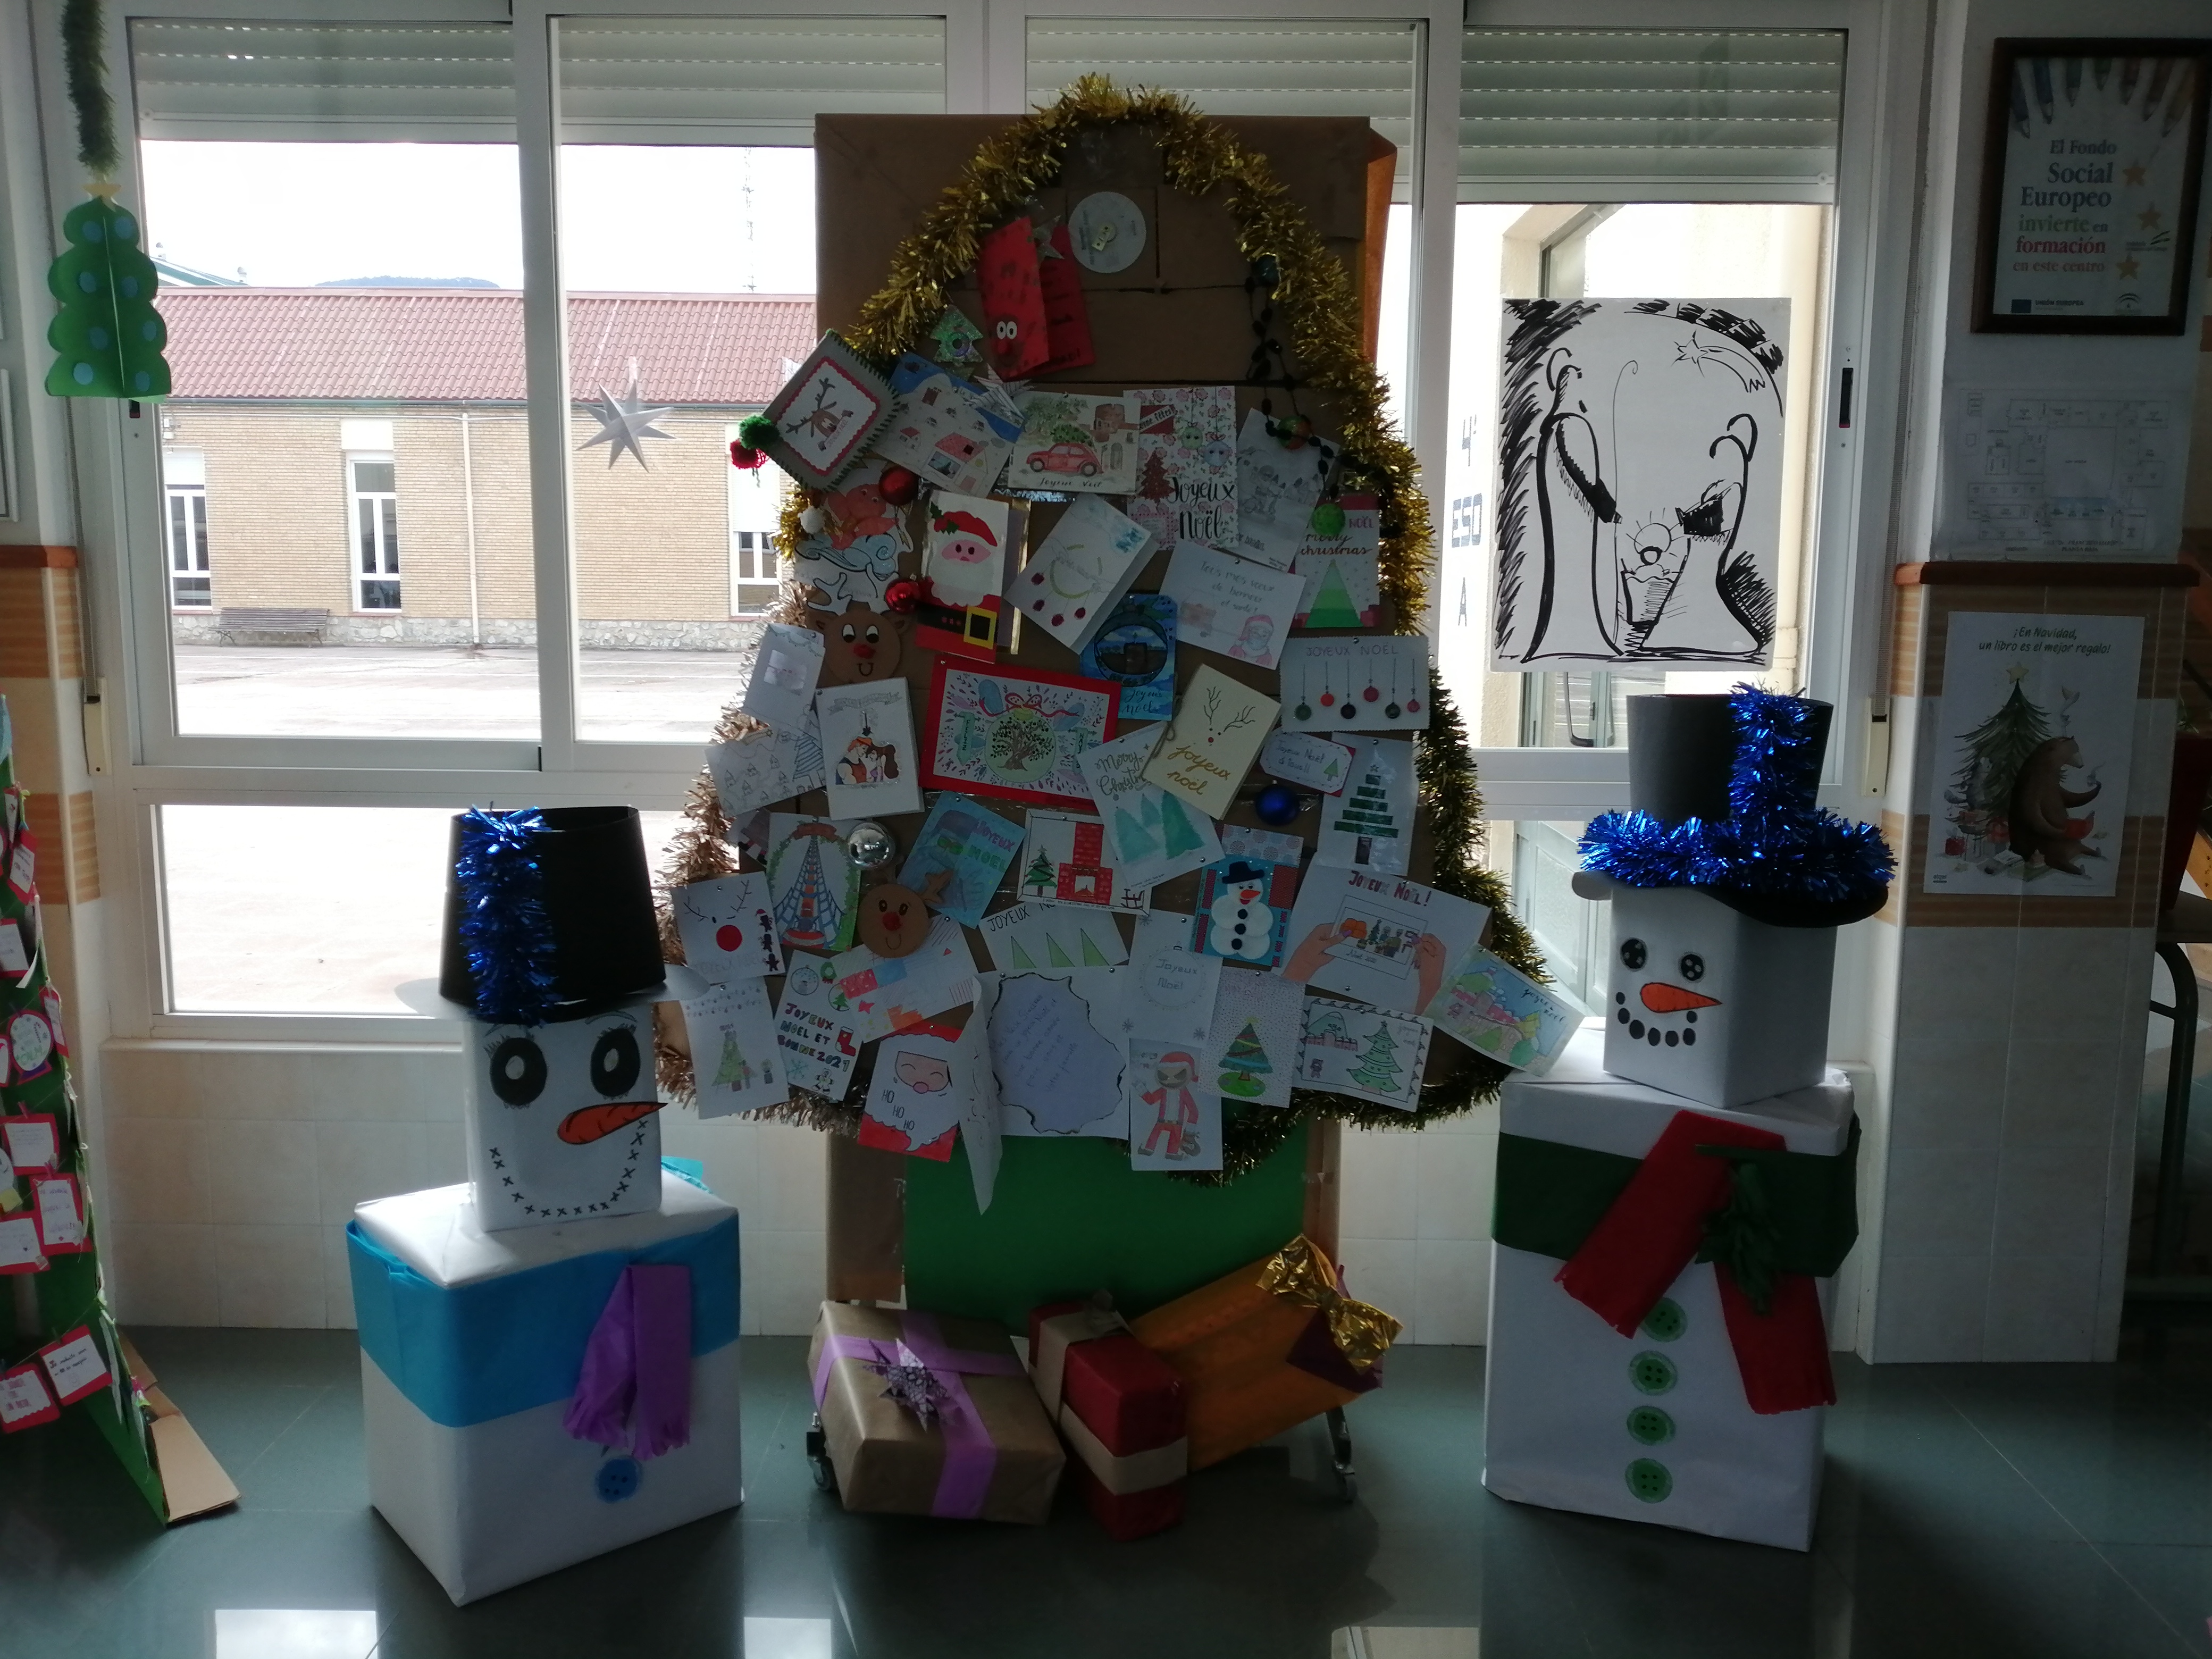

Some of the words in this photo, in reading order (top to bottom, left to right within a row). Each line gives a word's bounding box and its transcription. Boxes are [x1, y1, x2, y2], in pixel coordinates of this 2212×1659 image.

[2050, 139, 2065, 154] El
[2069, 139, 2117, 155] Fondo
[2048, 162, 2114, 183] Social
[2021, 186, 2112, 213] Europeo
[2018, 214, 2089, 232] invierte
[2092, 223, 2108, 233] en
[2016, 235, 2106, 254] formación
[2013, 262, 2029, 272] en
[2033, 261, 2059, 272] este
[2063, 261, 2105, 272] centro
[1163, 476, 1235, 509] Joyeux
[1179, 505, 1222, 540] Noël
[1452, 492, 1482, 548] ESO
[1457, 577, 1467, 627] A
[2033, 627, 2077, 641] Navidad,
[1305, 646, 1351, 657] JOYEUX
[1993, 639, 2017, 651] libro
[2020, 643, 2031, 651] es
[2033, 642, 2042, 652] el
[2043, 642, 2074, 655] mejor
[2075, 644, 2111, 657] regalo!
[1094, 751, 1145, 773] Merry
[973, 820, 1016, 852] JOYEUX
[986, 905, 1030, 932] JOYEUX
[1155, 958, 1197, 975] Joyeux
[784, 1002, 835, 1030] JOYEUX
[779, 1020, 809, 1039] NOEL
[814, 1033, 831, 1045] ET
[777, 1034, 816, 1057] BONNE
[816, 1051, 851, 1073] 2021
[881, 1089, 895, 1104] HO
[892, 1105, 905, 1119] HO
[903, 1119, 916, 1130] HO
